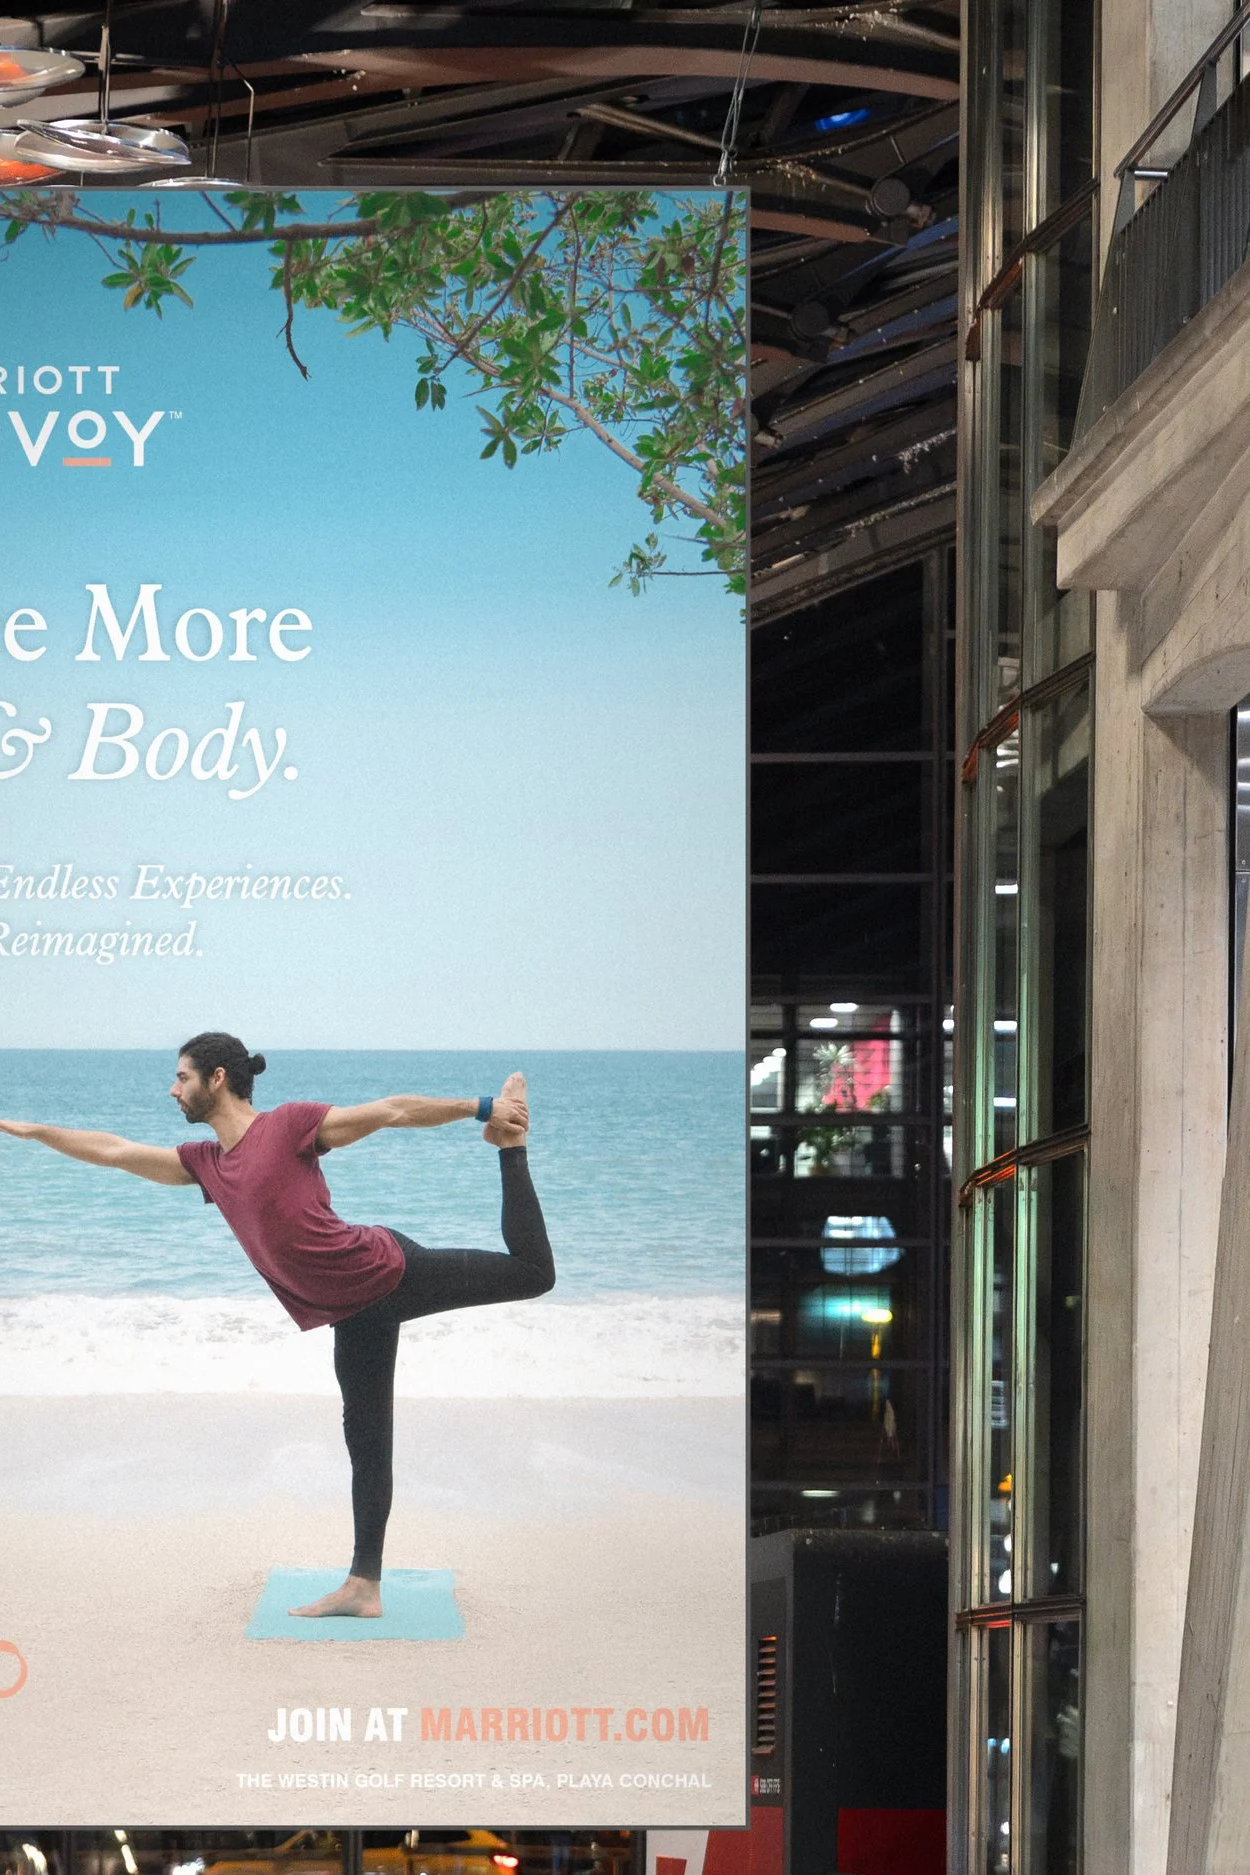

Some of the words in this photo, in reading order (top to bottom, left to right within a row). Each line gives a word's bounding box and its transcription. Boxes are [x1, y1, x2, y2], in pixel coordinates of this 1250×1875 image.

[75, 583, 313, 663] More
[68, 701, 299, 800] Body.
[129, 863, 352, 909] Experiences.
[267, 1707, 351, 1742] JOIN
[364, 1707, 408, 1742] AT
[420, 1707, 710, 1743] MARRIOTT.COM
[236, 1773, 272, 1788] THE
[278, 1773, 349, 1788] WESTIN
[355, 1773, 405, 1788] GOLF
[410, 1773, 486, 1788] RESORT
[491, 1773, 504, 1788] &
[509, 1773, 550, 1791] SPA,
[557, 1773, 614, 1788] PLAYA
[619, 1773, 712, 1788] CONCHAL
